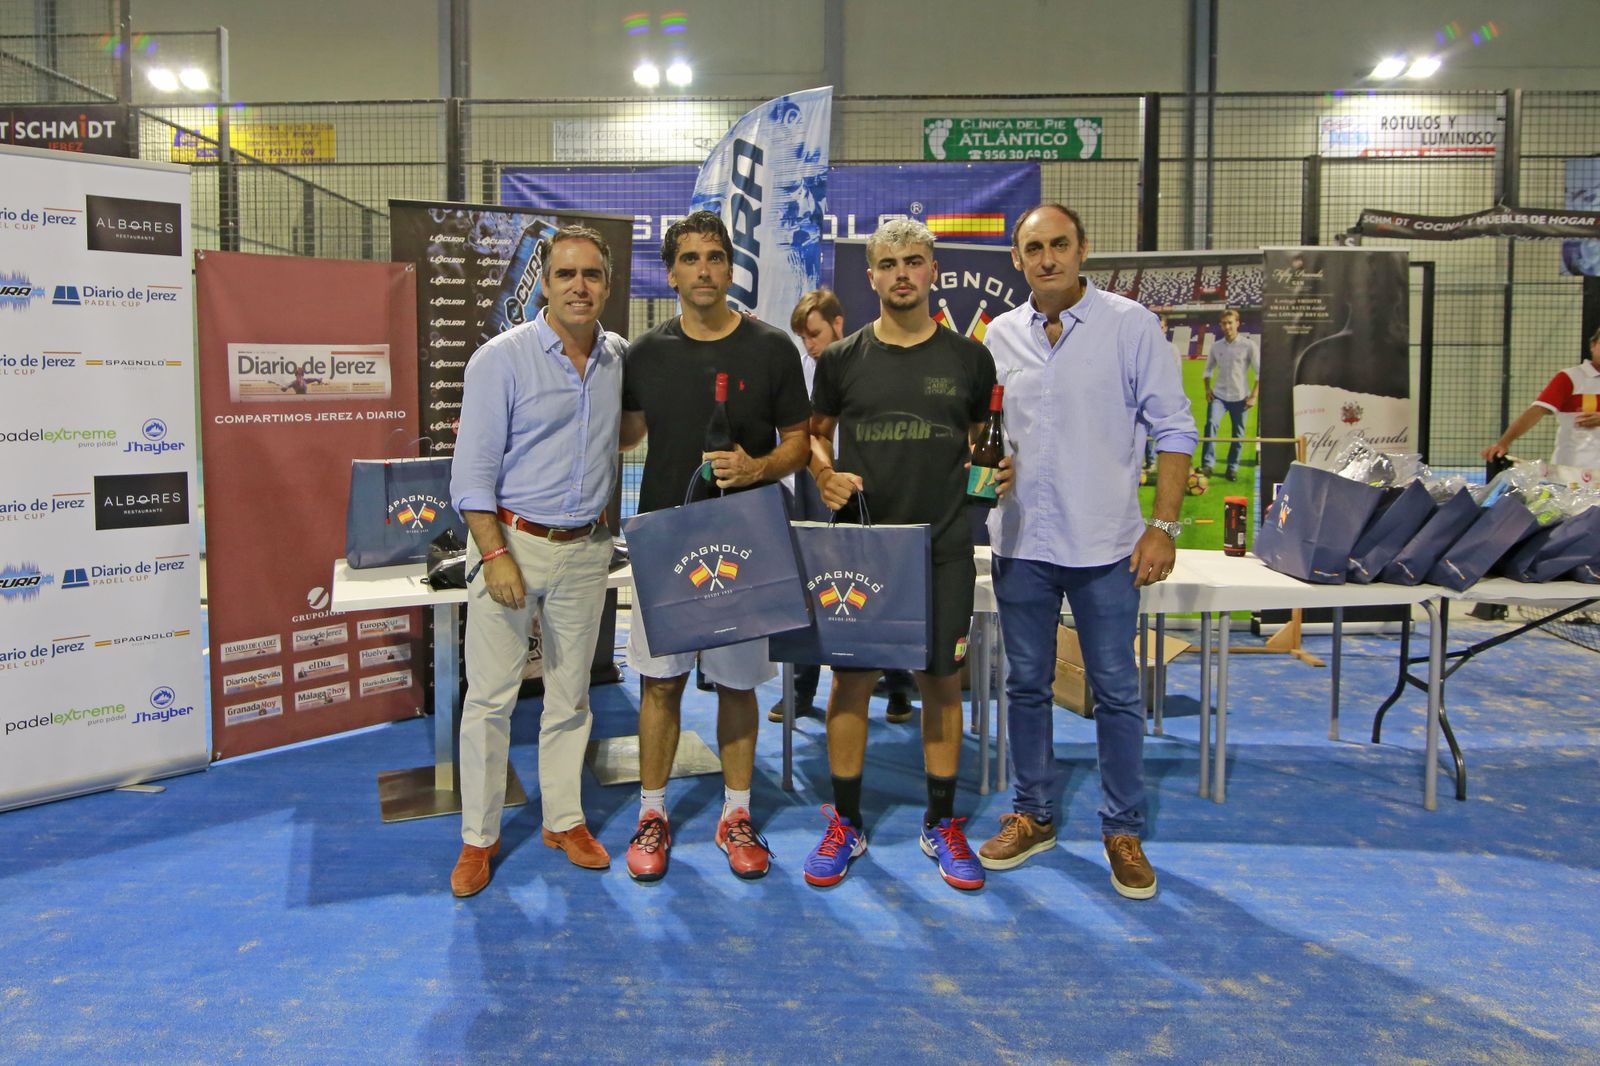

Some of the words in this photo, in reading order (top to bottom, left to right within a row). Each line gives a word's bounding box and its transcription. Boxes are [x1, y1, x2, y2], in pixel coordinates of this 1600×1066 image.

[1016, 119, 1038, 129] DEL
[1045, 118, 1066, 129] PIE
[1448, 116, 1457, 129] Y
[959, 131, 1068, 146] ATLÁNTICO
[983, 149, 1007, 159] 956
[1008, 149, 1024, 159] 30
[1043, 149, 1058, 159] 05
[21, 209, 39, 222] de
[42, 211, 77, 226] Jerez
[1476, 214, 1529, 225] MUEBLES
[1530, 215, 1546, 224] DE
[1548, 216, 1595, 226] HOGAR
[96, 217, 174, 234] ALBORES
[430, 234, 465, 243] LOCURA
[430, 255, 465, 264] LOCURA
[430, 276, 465, 285] LOCURA
[82, 285, 124, 299] Diario
[131, 287, 143, 299] de
[146, 289, 177, 302] Jerez
[430, 297, 465, 306] LOCURA
[430, 318, 465, 327] LOCURA
[430, 338, 465, 348] LOCURA
[20, 354, 38, 367] de
[41, 355, 75, 370] Jerez
[238, 355, 297, 375] Diario
[302, 356, 326, 375] de
[329, 356, 376, 380] Jerez
[430, 359, 465, 369] LOCURA
[214, 413, 312, 424] COMPARTIMOS
[314, 412, 353, 421] JEREZ
[355, 412, 364, 420] A
[366, 410, 406, 420] DIARIO
[30, 498, 48, 511] de
[51, 497, 85, 513] Jerez
[104, 492, 181, 507] ALBORES
[388, 494, 446, 513] SPAGNOLO
[674, 543, 750, 575] SPAGNOLO
[91, 564, 132, 578] Diario
[139, 561, 151, 573] de
[154, 560, 185, 575] Jerez
[93, 577, 125, 585] PADEL
[807, 570, 882, 593] SPAGNOLO
[113, 632, 173, 645] SPAGNOLO
[30, 645, 48, 657] de
[51, 642, 85, 658] Jerez
[361, 649, 388, 658] Huelva
[24, 658, 46, 667] CUP
[309, 661, 317, 669] el
[226, 676, 248, 686] Diario
[248, 674, 257, 682] de
[257, 671, 281, 679] Sevilla
[87, 718, 105, 727] puro
